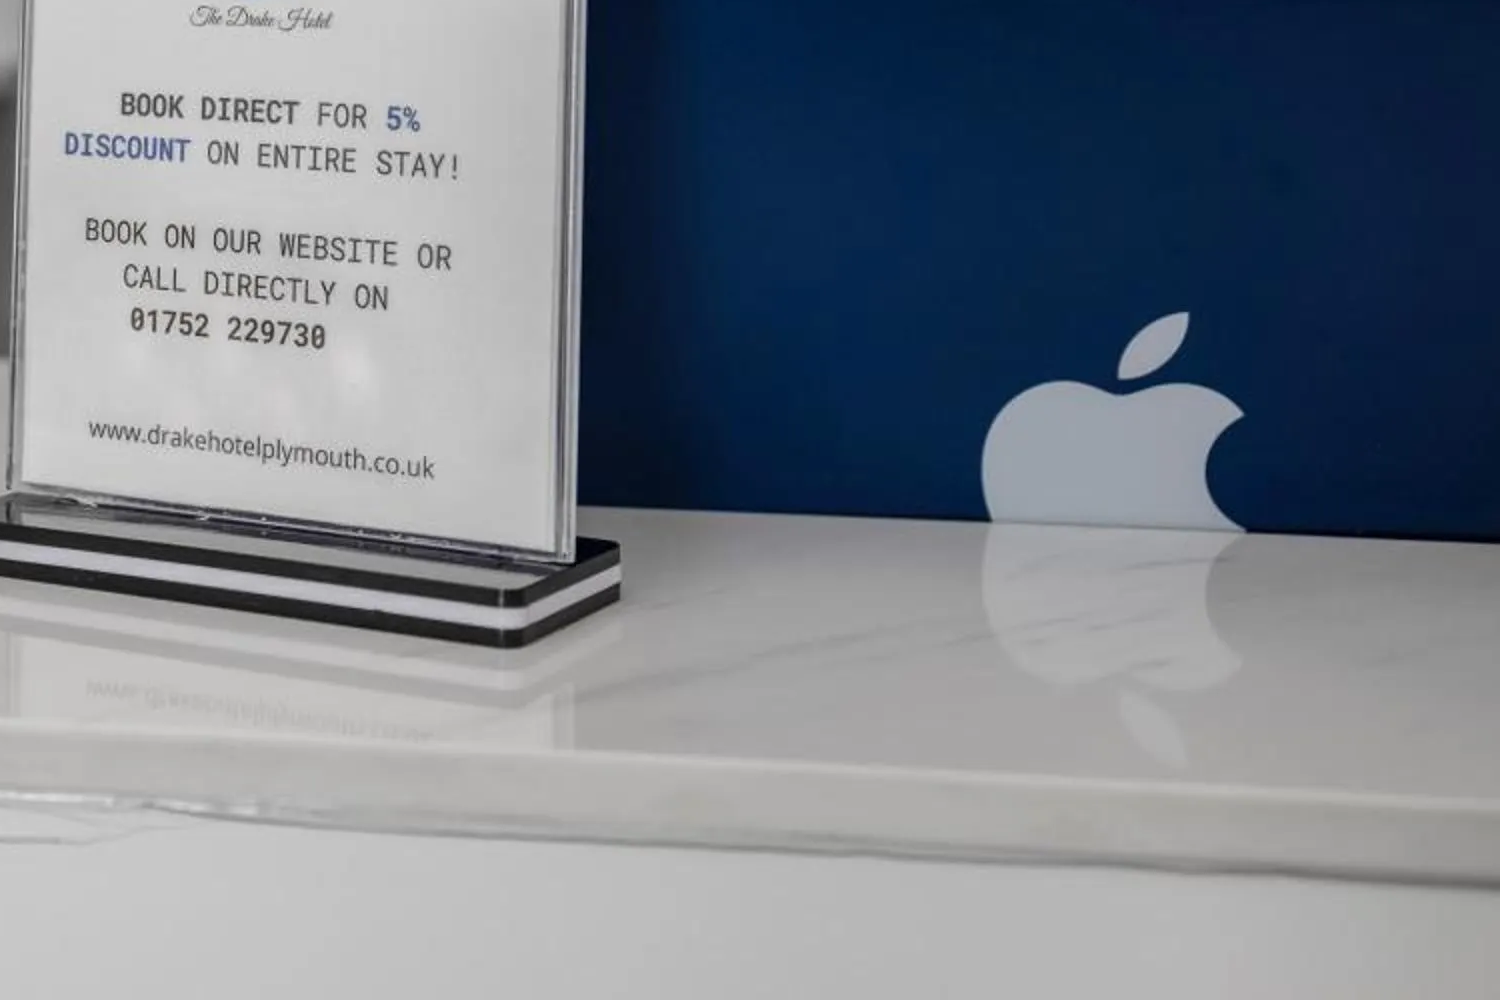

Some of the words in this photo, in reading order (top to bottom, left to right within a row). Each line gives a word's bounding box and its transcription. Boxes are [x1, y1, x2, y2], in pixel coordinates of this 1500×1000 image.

[189, 4, 223, 27] The
[225, 5, 275, 28] Drake
[278, 7, 334, 32] Hotel
[120, 91, 185, 120] BOOK
[200, 95, 302, 126] DIRECT
[316, 101, 368, 130] FOR
[385, 104, 421, 133] 5%
[63, 130, 193, 163] DISCOUNT
[206, 139, 240, 167] ON
[256, 142, 357, 174] ENTIRE
[375, 149, 458, 181] STAY!
[85, 217, 148, 247] BOOK
[163, 223, 196, 250] ON
[212, 226, 262, 256] OUR
[278, 231, 399, 268] WEBSITE
[416, 242, 452, 272] OR
[122, 263, 187, 293] CALL
[203, 269, 338, 306] DIRECTLY
[353, 283, 389, 311] ON
[130, 306, 210, 339] 01752
[227, 315, 326, 351] 229730
[87, 420, 436, 481] www.drakehotelplymouth.co.uk
